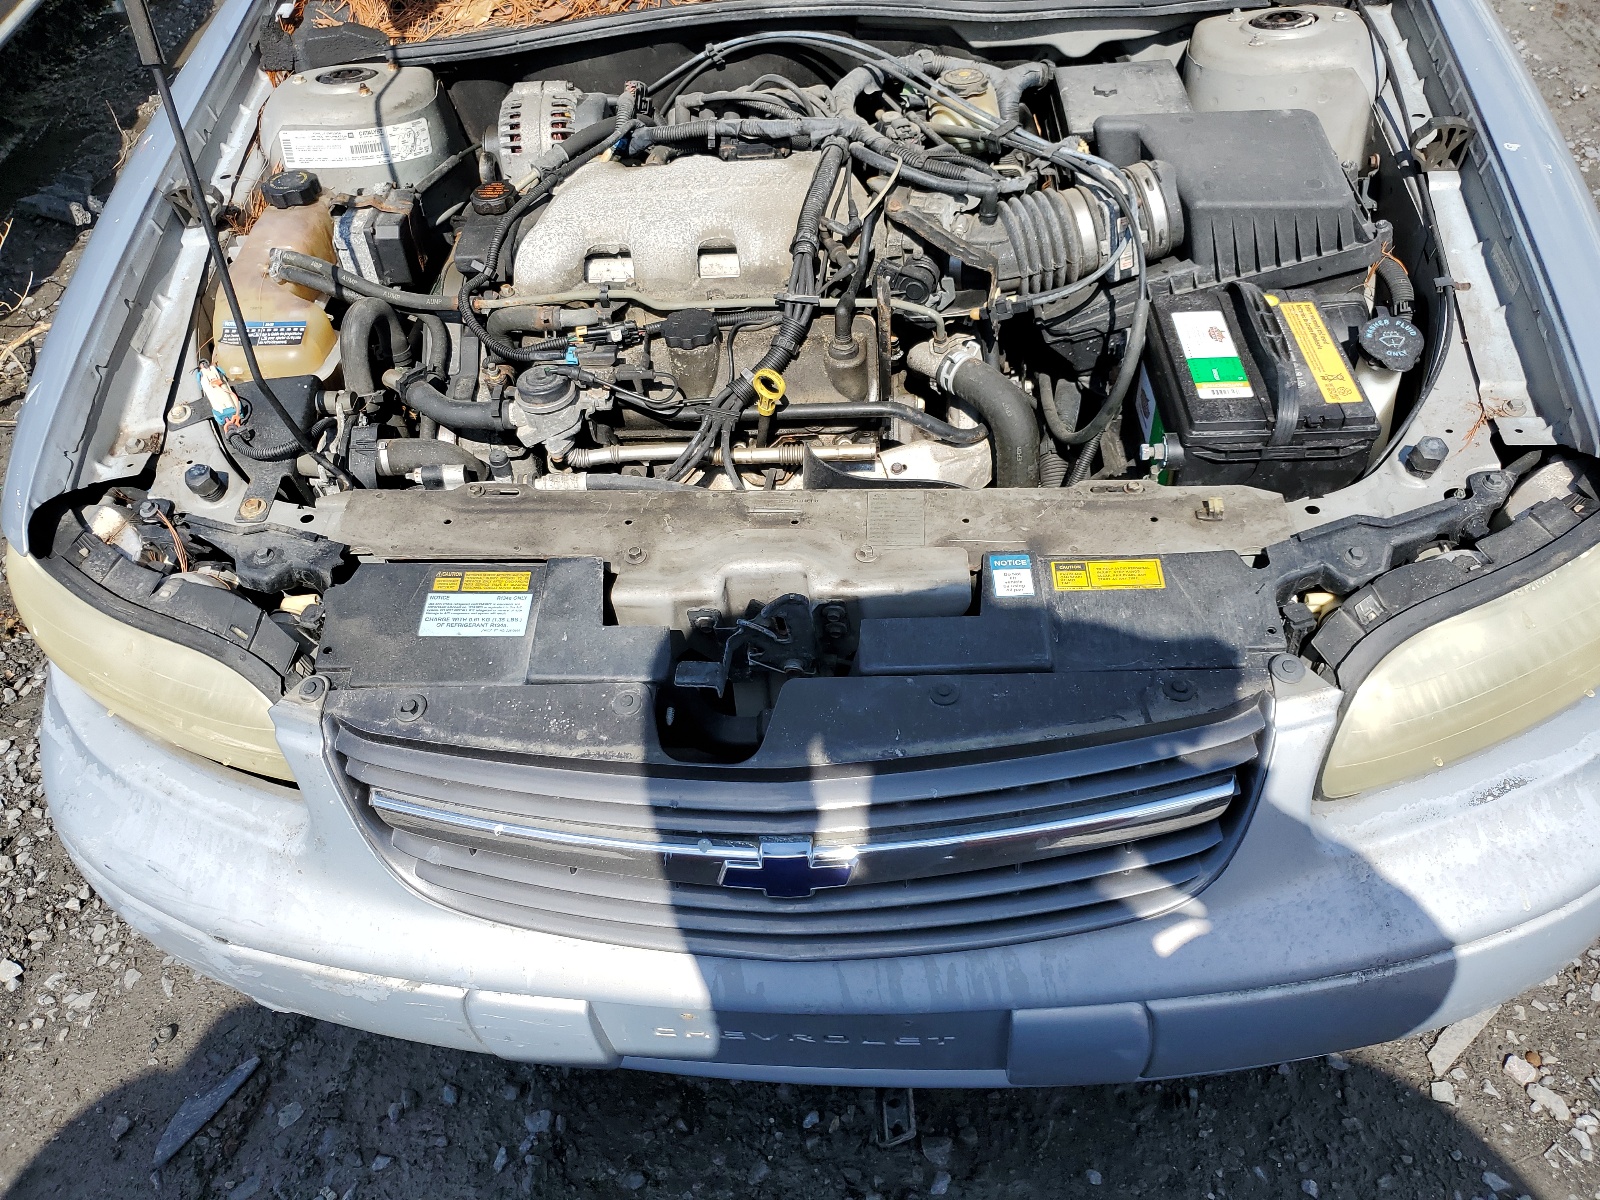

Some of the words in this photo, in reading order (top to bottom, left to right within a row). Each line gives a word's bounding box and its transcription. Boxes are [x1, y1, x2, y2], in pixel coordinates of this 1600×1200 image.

[1365, 319, 1389, 338] WASHER
[1395, 320, 1417, 336] FLUID
[1386, 349, 1408, 357] ONLY
[653, 1026, 956, 1046] CHEVROLET
